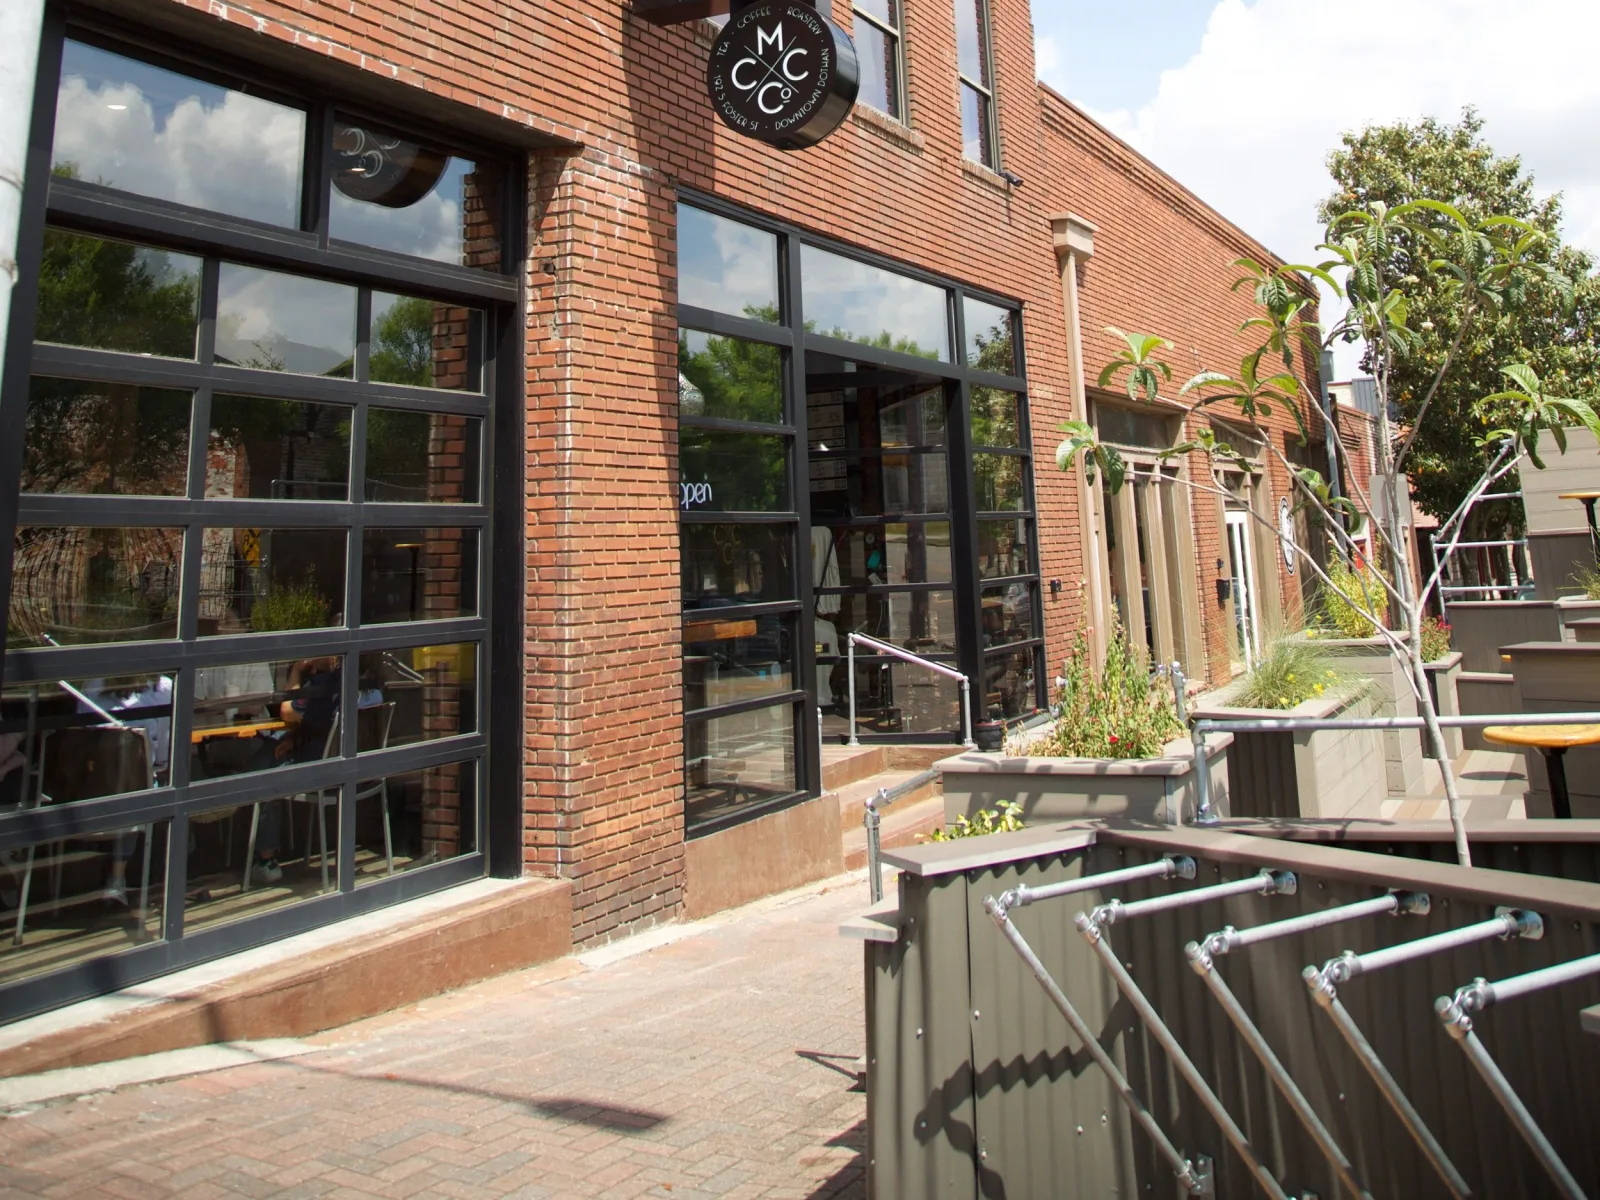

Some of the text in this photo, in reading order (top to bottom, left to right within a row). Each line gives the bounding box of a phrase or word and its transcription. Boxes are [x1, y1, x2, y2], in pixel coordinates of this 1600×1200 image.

[717, 6, 822, 56] TEA COFFEE ROASTERY
[757, 21, 783, 56] M
[731, 48, 809, 90] C C
[775, 48, 829, 130] DOWNTOWN DOTHAN
[714, 75, 759, 131] 192 S FOSTER ST
